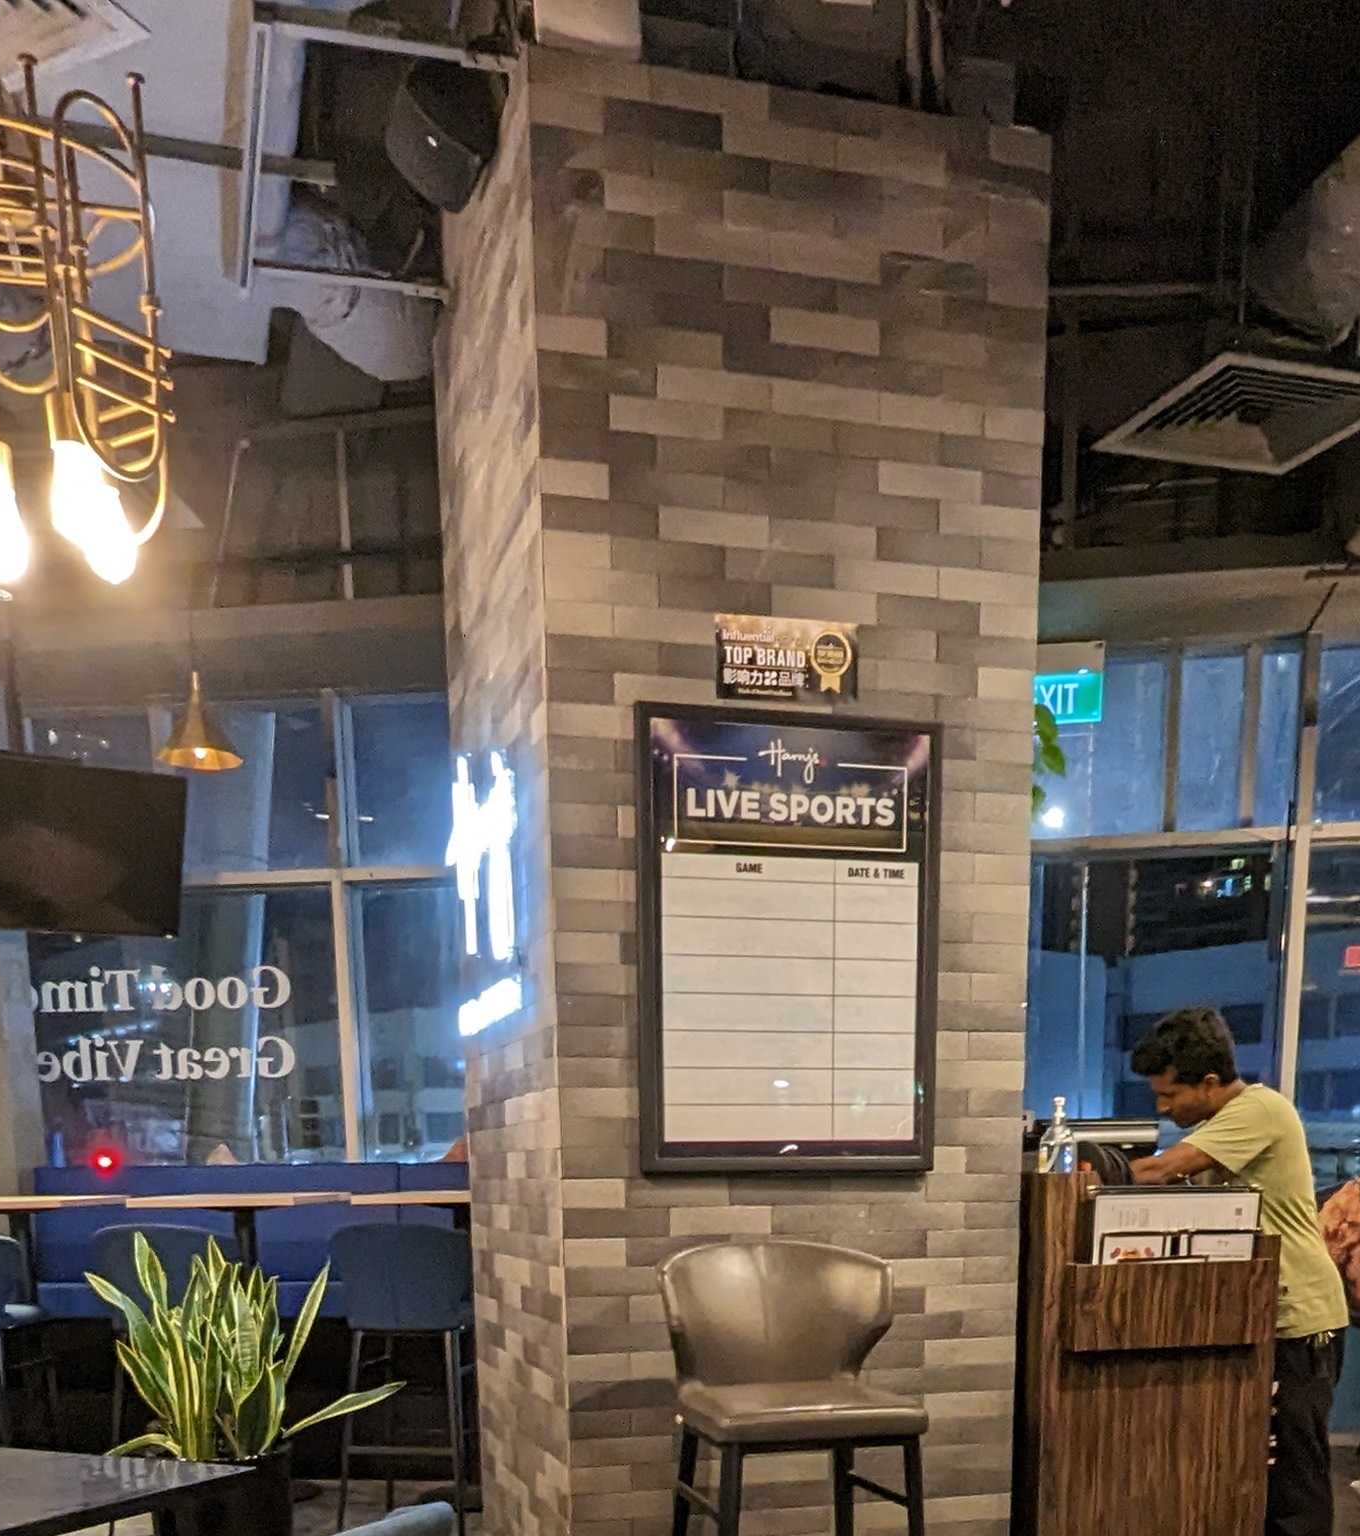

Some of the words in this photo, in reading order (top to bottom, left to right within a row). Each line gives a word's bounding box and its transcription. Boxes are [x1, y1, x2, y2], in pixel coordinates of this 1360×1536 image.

[723, 645, 753, 665] TOP
[756, 647, 806, 669] BRAND
[1034, 684, 1079, 714] XIT
[686, 788, 761, 822] LIVE
[769, 792, 896, 828] SPORTS
[736, 862, 763, 875] GAME
[848, 867, 870, 879] DATE
[873, 867, 880, 879] &
[883, 868, 906, 880] TIME
